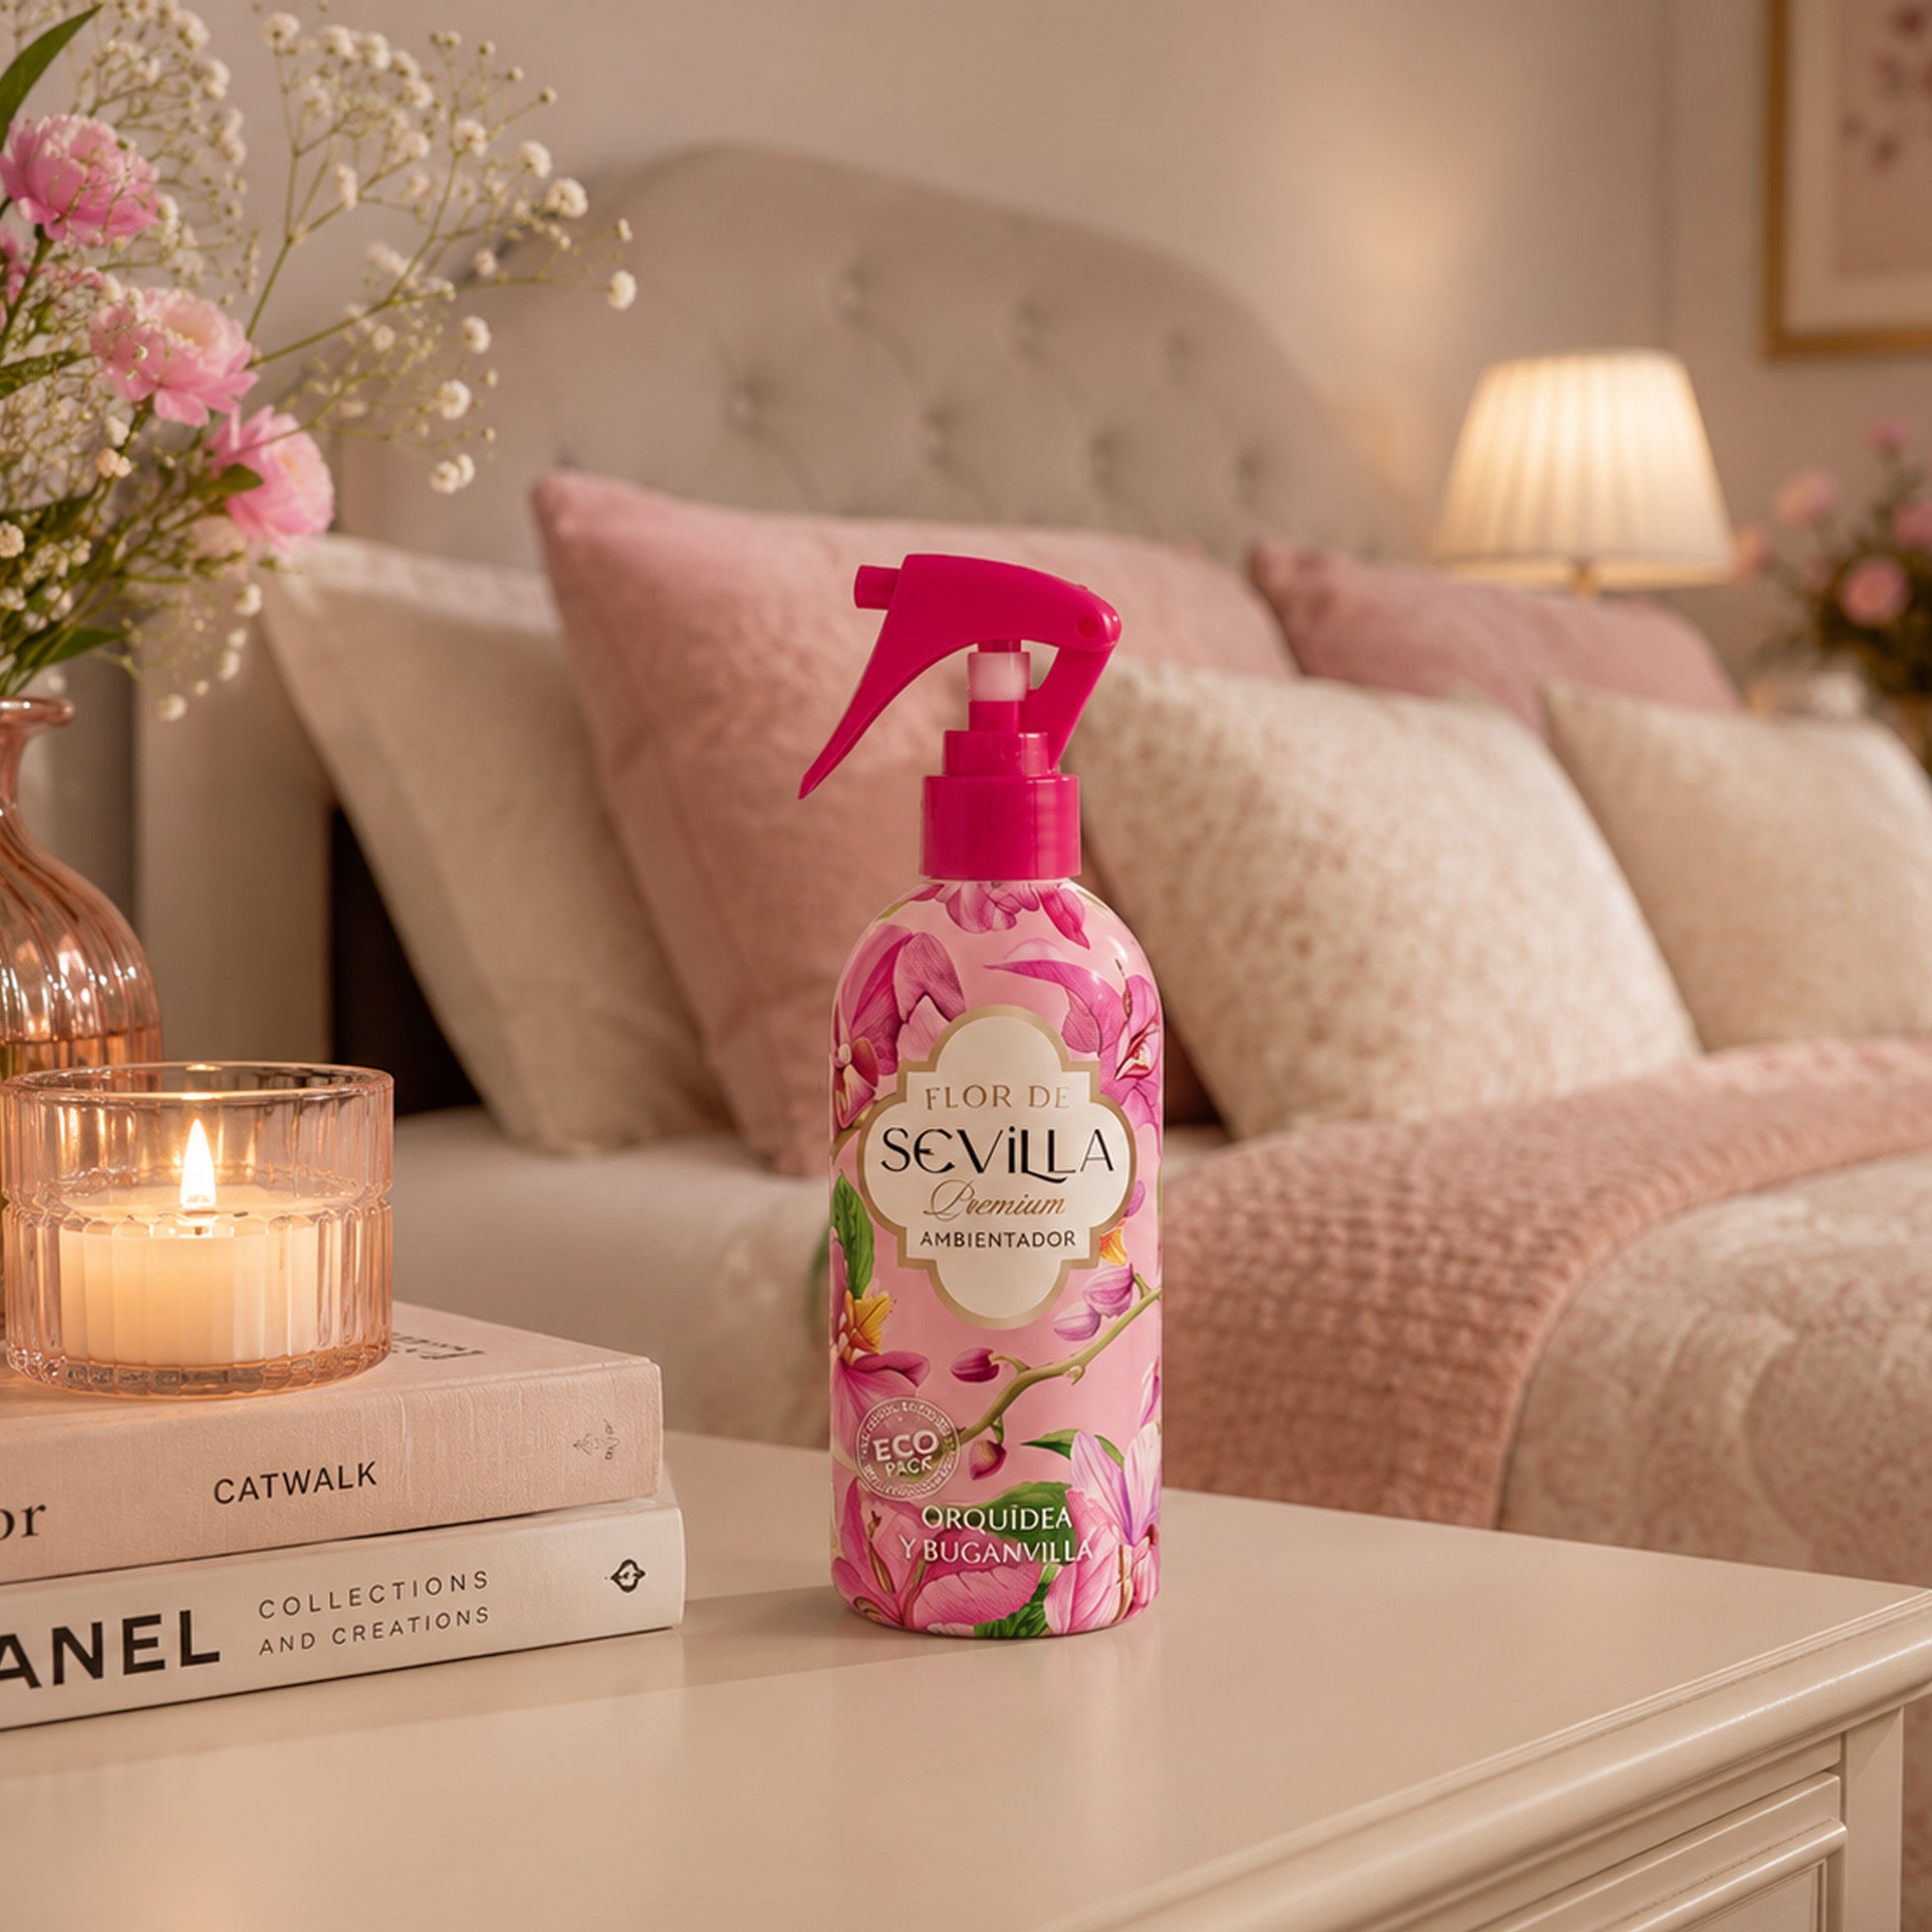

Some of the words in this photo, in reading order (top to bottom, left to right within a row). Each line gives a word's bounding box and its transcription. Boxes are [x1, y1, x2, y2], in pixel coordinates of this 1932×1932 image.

[925, 1084, 1012, 1110] FLOR
[1029, 1084, 1070, 1109] DE
[923, 1179, 1066, 1221] Premium
[920, 1230, 1076, 1249] AMBIENTADOR
[872, 1429, 939, 1463] ECO
[213, 1461, 378, 1505] CATWALK
[885, 1455, 933, 1478] PACK
[898, 1533, 917, 1560] Y
[923, 1539, 1094, 1565] BUGANVILLA
[258, 1570, 489, 1619] COLLECTIONS
[0, 1609, 221, 1690] ANEL
[259, 1632, 316, 1656] AND
[331, 1605, 490, 1645] CREATIONS
